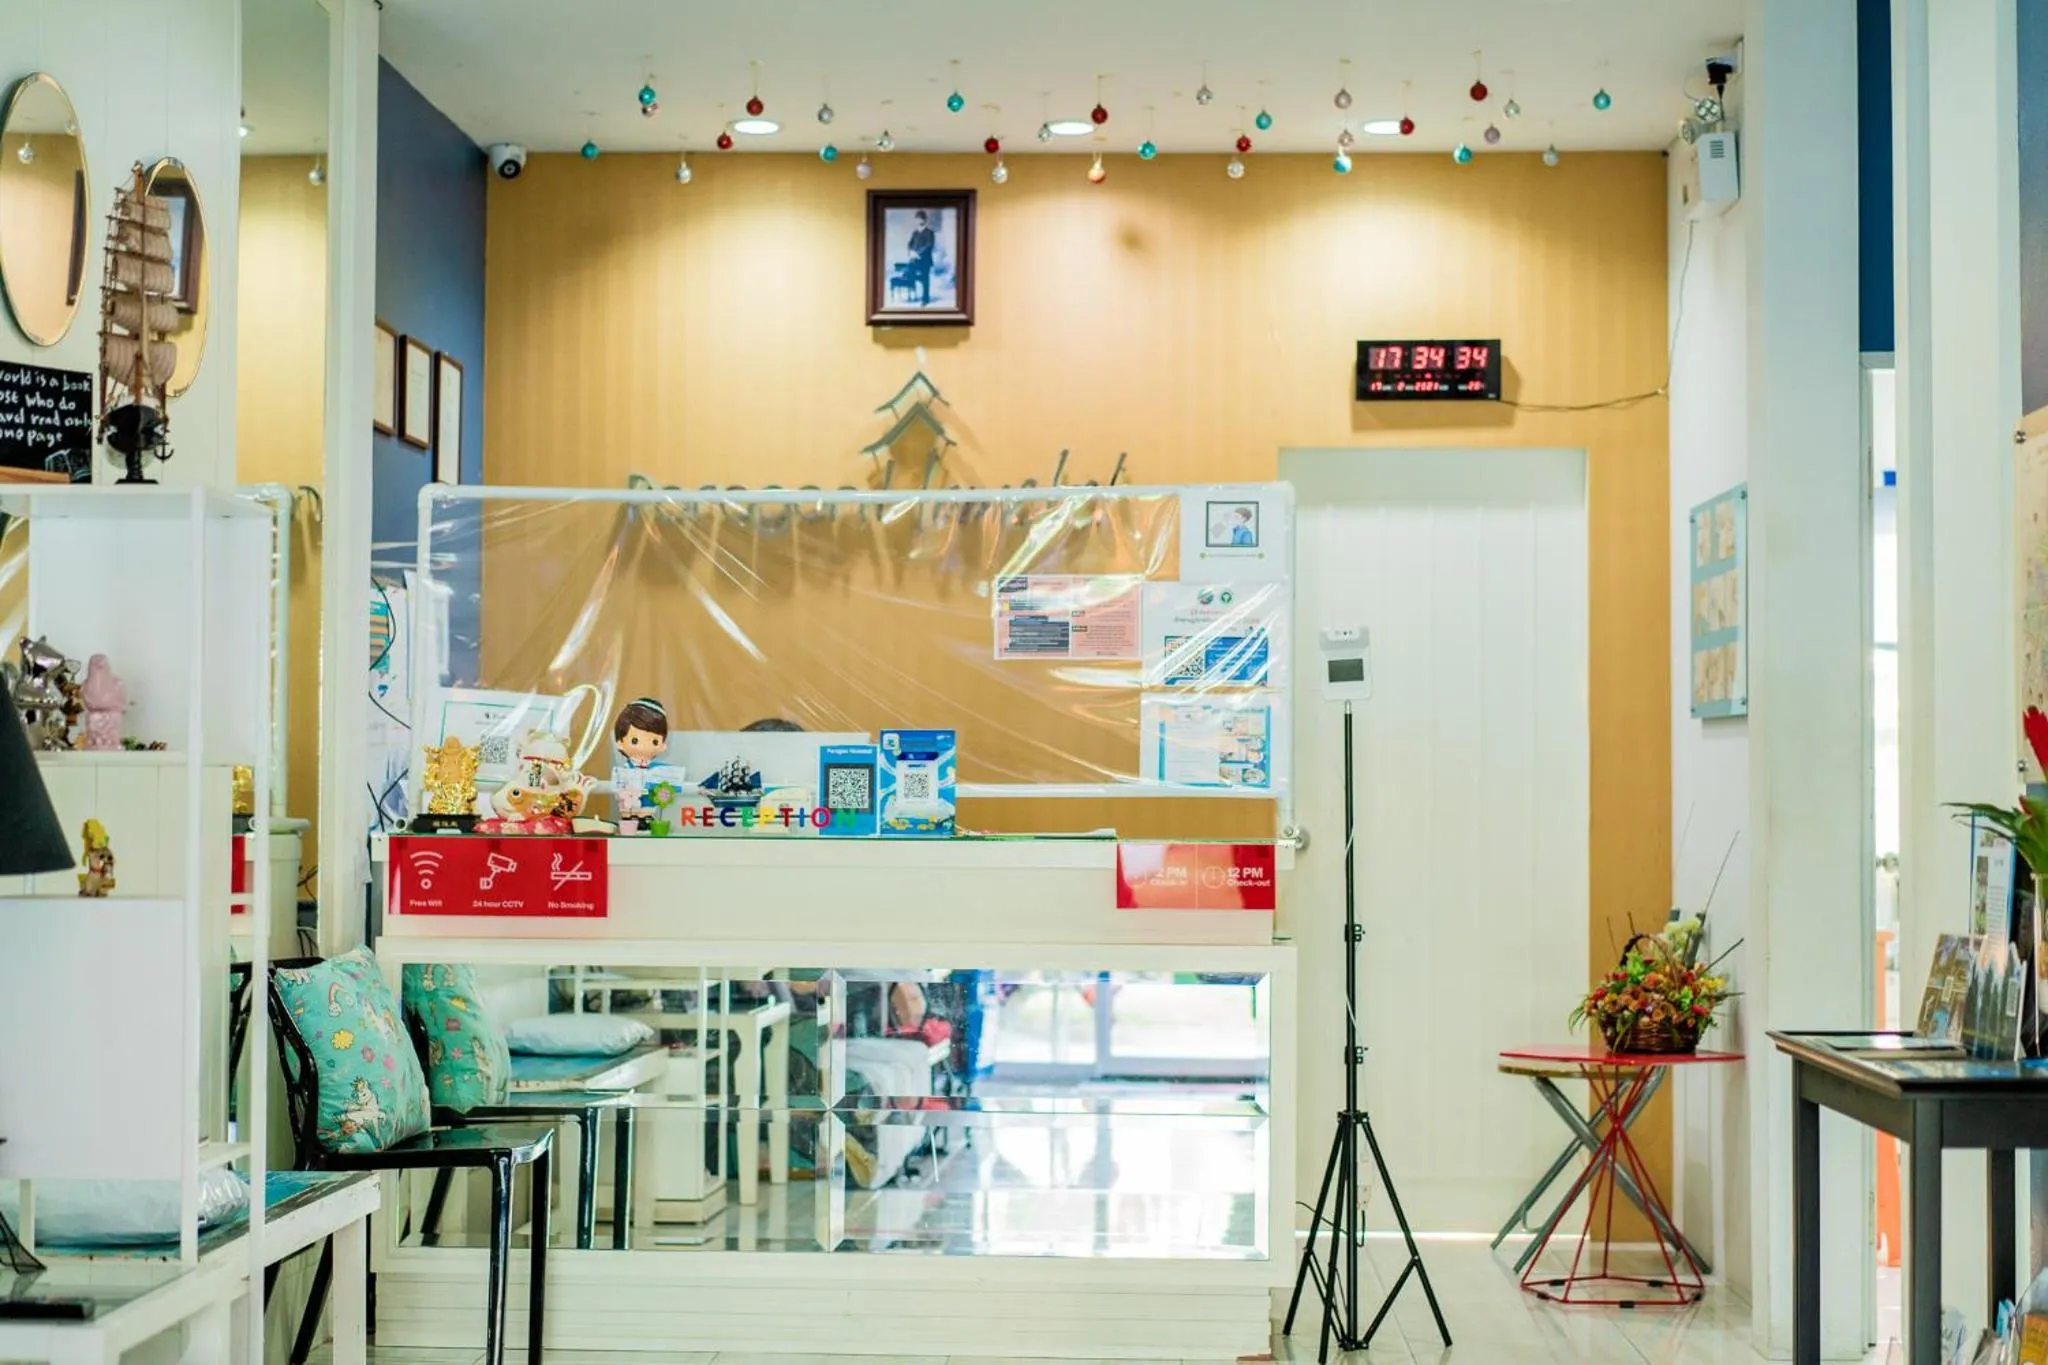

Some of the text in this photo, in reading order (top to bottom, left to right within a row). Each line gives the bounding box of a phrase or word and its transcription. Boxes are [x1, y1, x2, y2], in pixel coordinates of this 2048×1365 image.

[1371, 345, 1489, 370] 17 34 34
[34, 371, 46, 387] is
[49, 377, 59, 387] a
[62, 374, 91, 391] book
[25, 391, 54, 408] who
[59, 396, 76, 410] do
[31, 409, 60, 426] read
[64, 412, 93, 435] only
[27, 430, 63, 448] page
[680, 806, 858, 829] RECEPTION
[1167, 867, 1188, 878] PM
[1227, 867, 1264, 878] 12 PM
[1227, 879, 1271, 887] Check-out
[409, 899, 427, 908] Free
[472, 899, 525, 909] 24 hour CCTV
[548, 901, 595, 911] No Smoking
